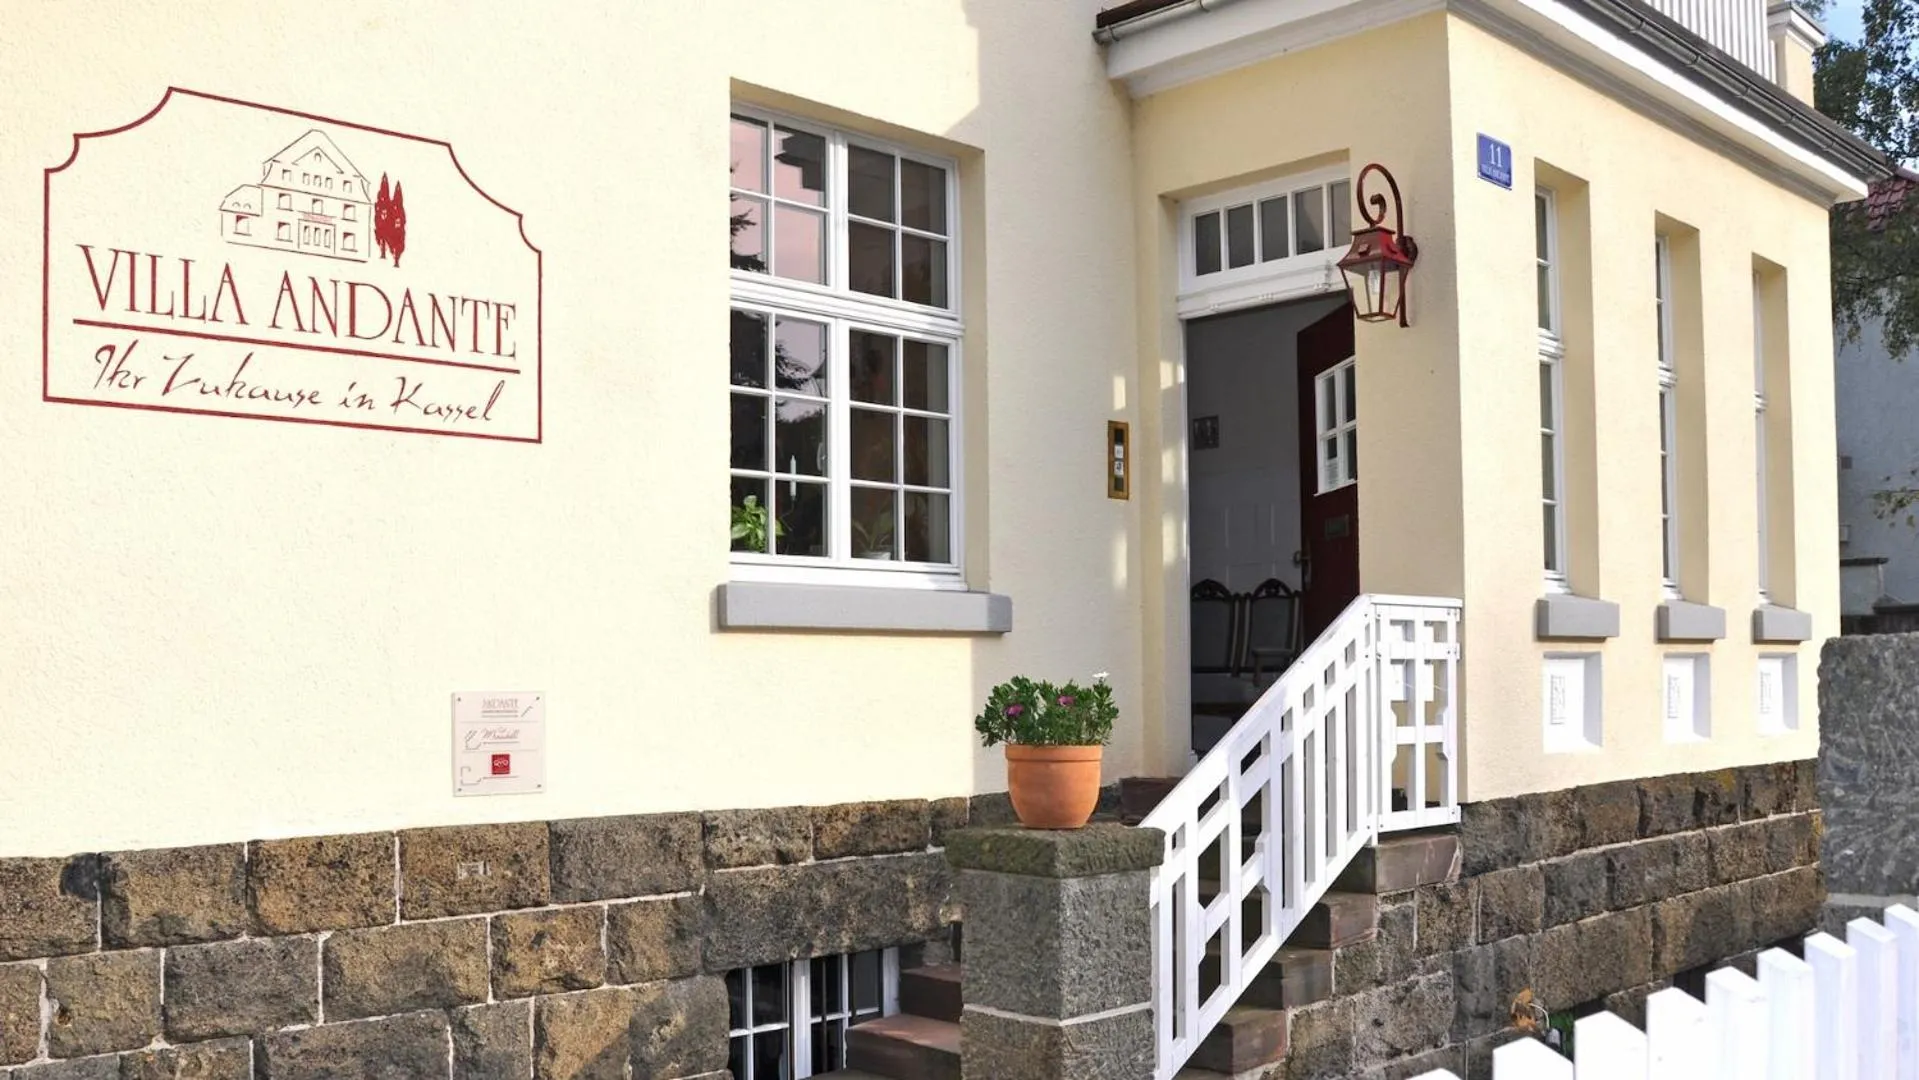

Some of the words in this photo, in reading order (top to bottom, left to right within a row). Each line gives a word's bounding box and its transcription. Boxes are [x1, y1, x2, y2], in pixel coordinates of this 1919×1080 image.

[1490, 143, 1502, 168] 11
[75, 243, 250, 325] VILLA
[268, 269, 517, 360] ANDANTE
[93, 338, 147, 390] Ihr
[162, 351, 323, 409] Zuhause
[338, 381, 376, 411] in
[390, 375, 505, 424] Kassel
